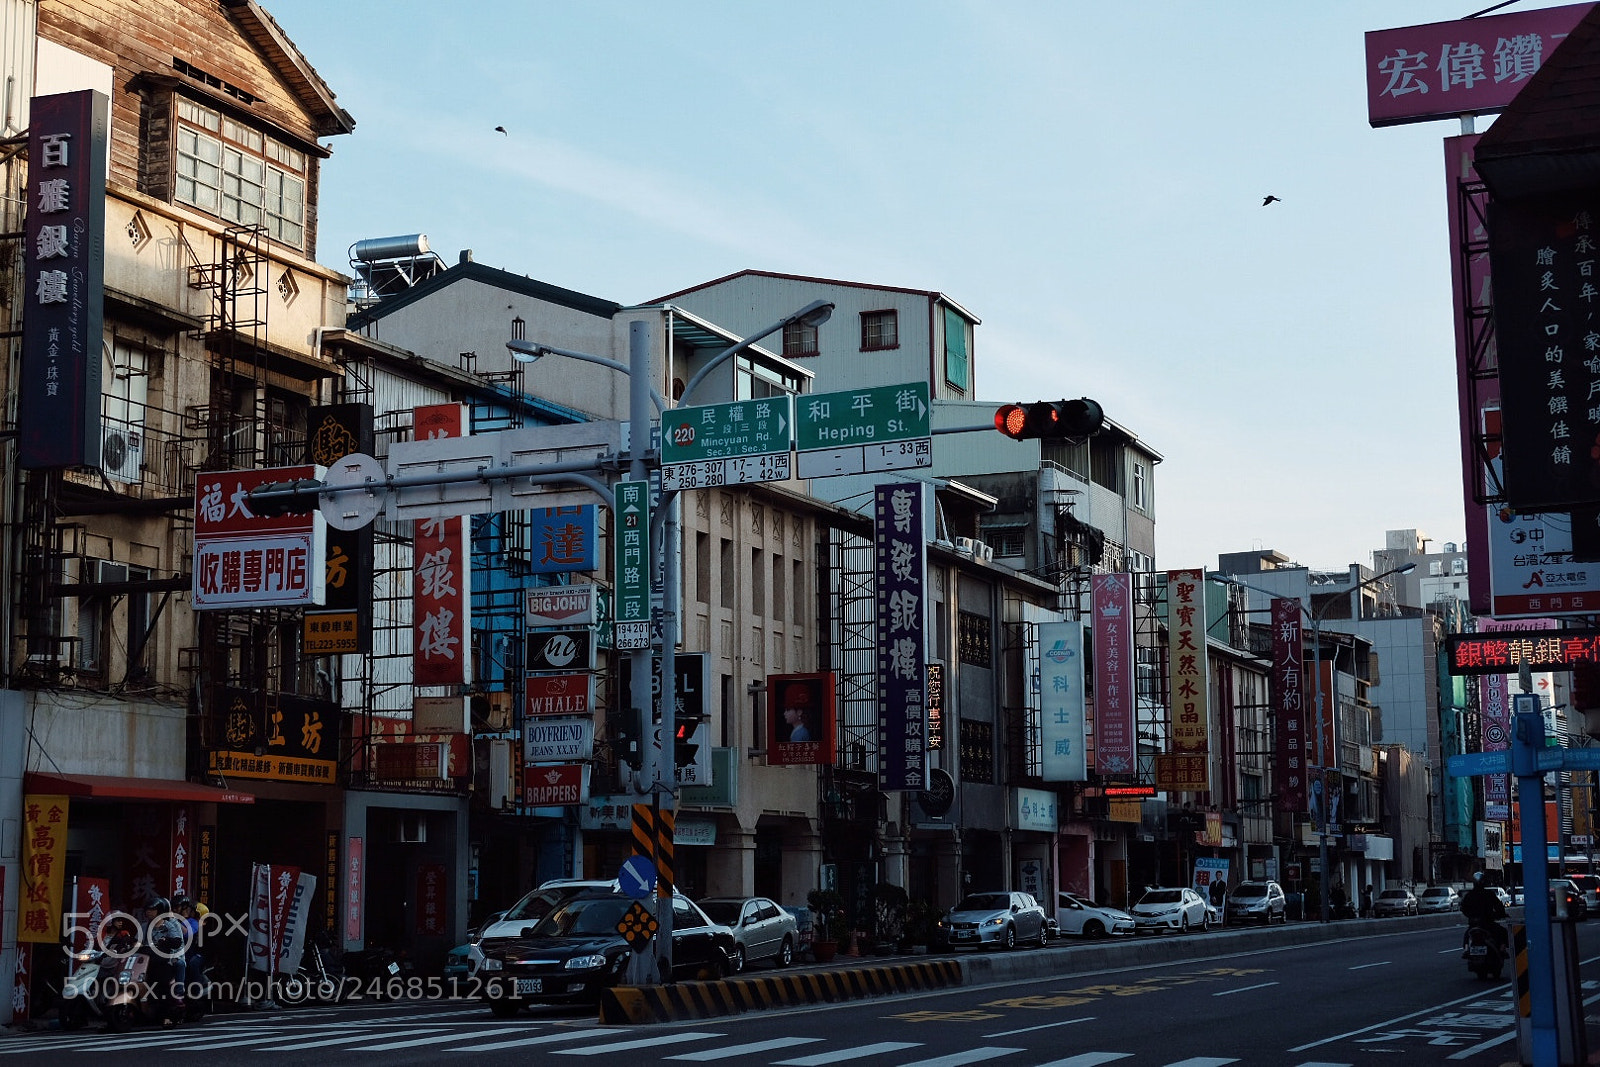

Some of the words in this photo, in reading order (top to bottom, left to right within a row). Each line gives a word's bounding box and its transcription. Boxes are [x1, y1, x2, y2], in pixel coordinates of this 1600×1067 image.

[1378, 33, 1569, 98] 宏偉鑽
[35, 132, 72, 305] 百雅銀樓
[701, 403, 771, 425] 民權路
[809, 390, 917, 422] 和平街
[674, 426, 696, 443] 220
[819, 424, 875, 441] Heping
[888, 420, 909, 433] St.
[701, 435, 748, 448] Mincyuan
[756, 432, 772, 442] Rd.
[915, 441, 929, 456] 西
[707, 447, 731, 457] Sec.2
[742, 444, 767, 454] Sec.3
[679, 462, 723, 476] 276-307
[775, 455, 788, 468] 西
[663, 467, 676, 481] 東
[679, 474, 723, 489] 250-280
[623, 486, 640, 503] 南
[626, 515, 637, 526] 21
[199, 547, 308, 595] 收購專門店
[623, 530, 641, 618] 西門路二段
[1545, 571, 1587, 583] 亞太電信
[1528, 596, 1584, 610] 西門店
[617, 624, 632, 635] 194
[633, 622, 648, 634] 201
[617, 637, 632, 648] 266
[633, 635, 648, 647] 273
[1176, 582, 1200, 724] 聖寶天然水晶
[1456, 635, 1600, 668] 銀幣龍銀高
[1106, 622, 1119, 710] 女王美容工作室
[1279, 620, 1301, 712] 新人有約
[531, 695, 585, 713] WHALE
[926, 665, 942, 749] 祝您行車平安
[1052, 675, 1071, 756] 科士威
[529, 724, 582, 743] BOYFRIEND
[904, 688, 922, 786] 高價收購黃金
[531, 745, 554, 756] JEANS
[527, 785, 578, 803] BRAPPERS
[26, 804, 64, 824] 黃金
[23, 825, 56, 934] 高價收購
